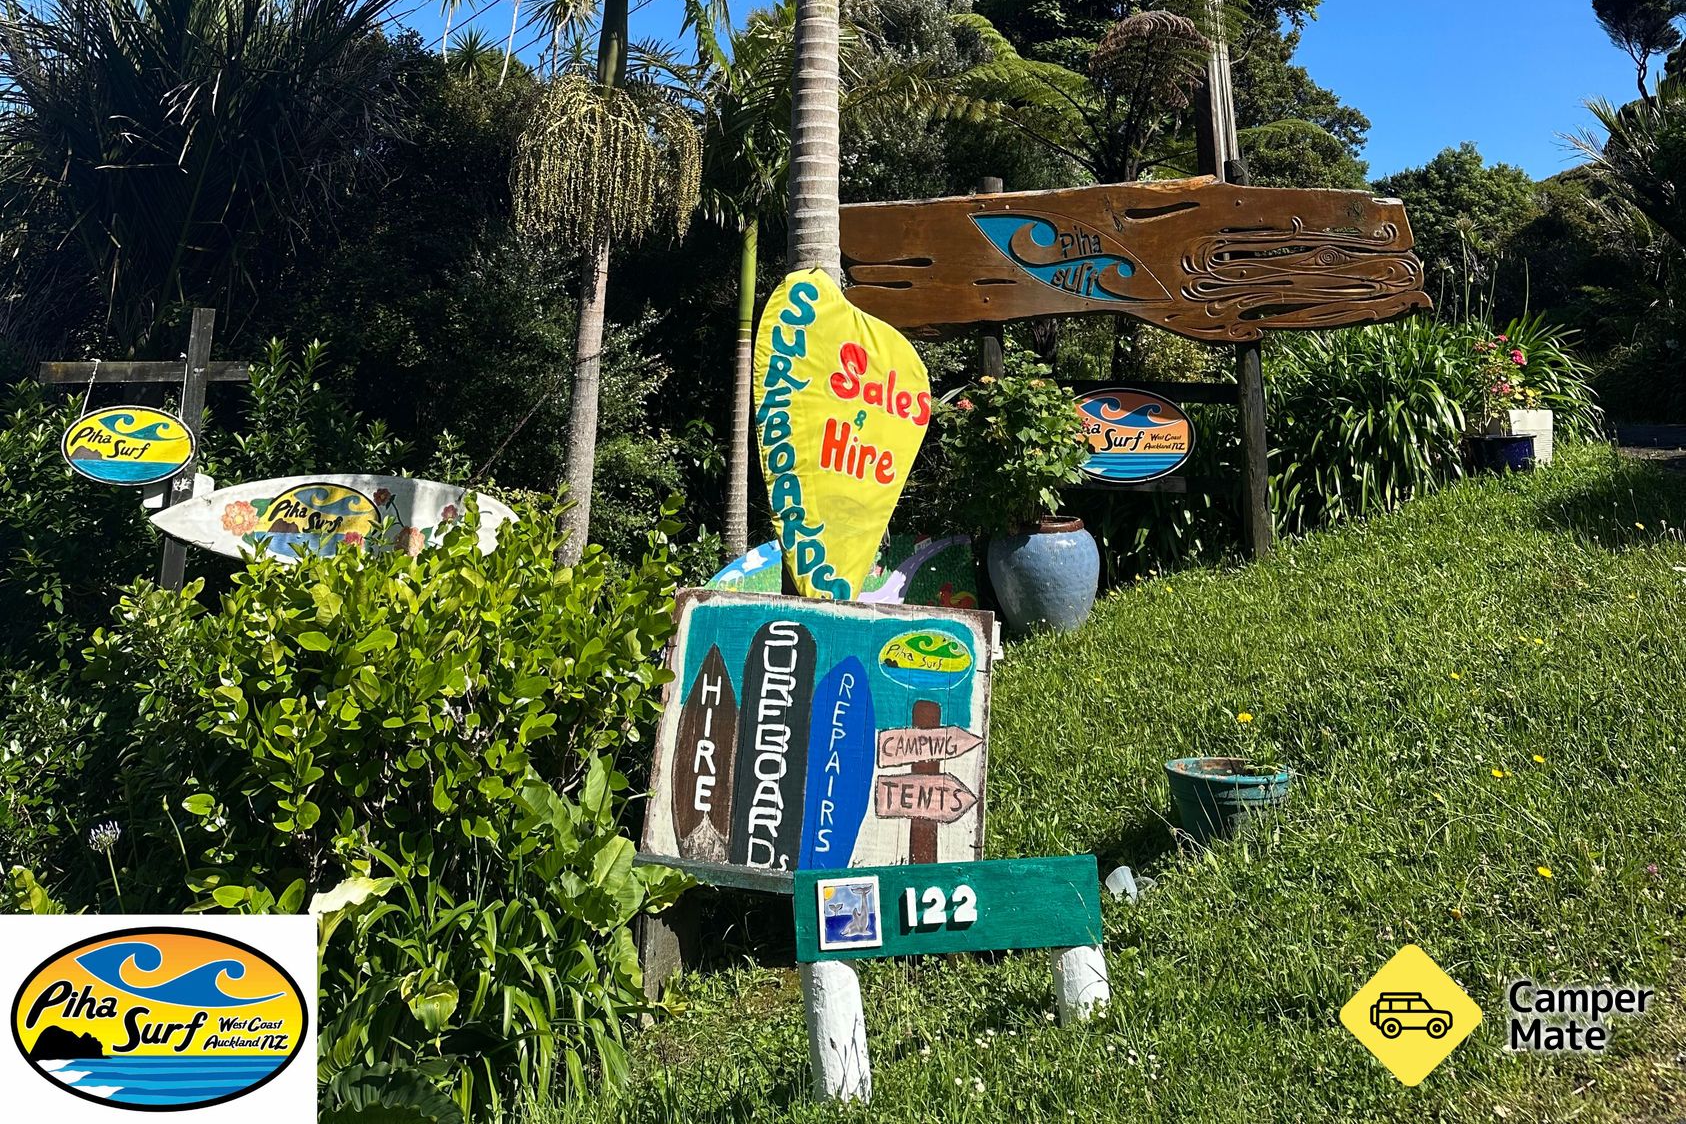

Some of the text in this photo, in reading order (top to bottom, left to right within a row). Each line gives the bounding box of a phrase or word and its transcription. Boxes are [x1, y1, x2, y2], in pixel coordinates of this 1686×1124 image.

[830, 343, 931, 426] Sales
[70, 426, 151, 459] Piha Surf
[757, 282, 851, 600] SURFBOARDS
[820, 418, 895, 484] Hire
[1100, 428, 1145, 452] Surf
[268, 499, 344, 533] Piha Surf
[693, 673, 722, 811] HIRE
[815, 673, 855, 852] REPAIRS
[881, 732, 958, 758] CAMPING
[882, 780, 964, 813] TENTS
[904, 885, 977, 927] 122
